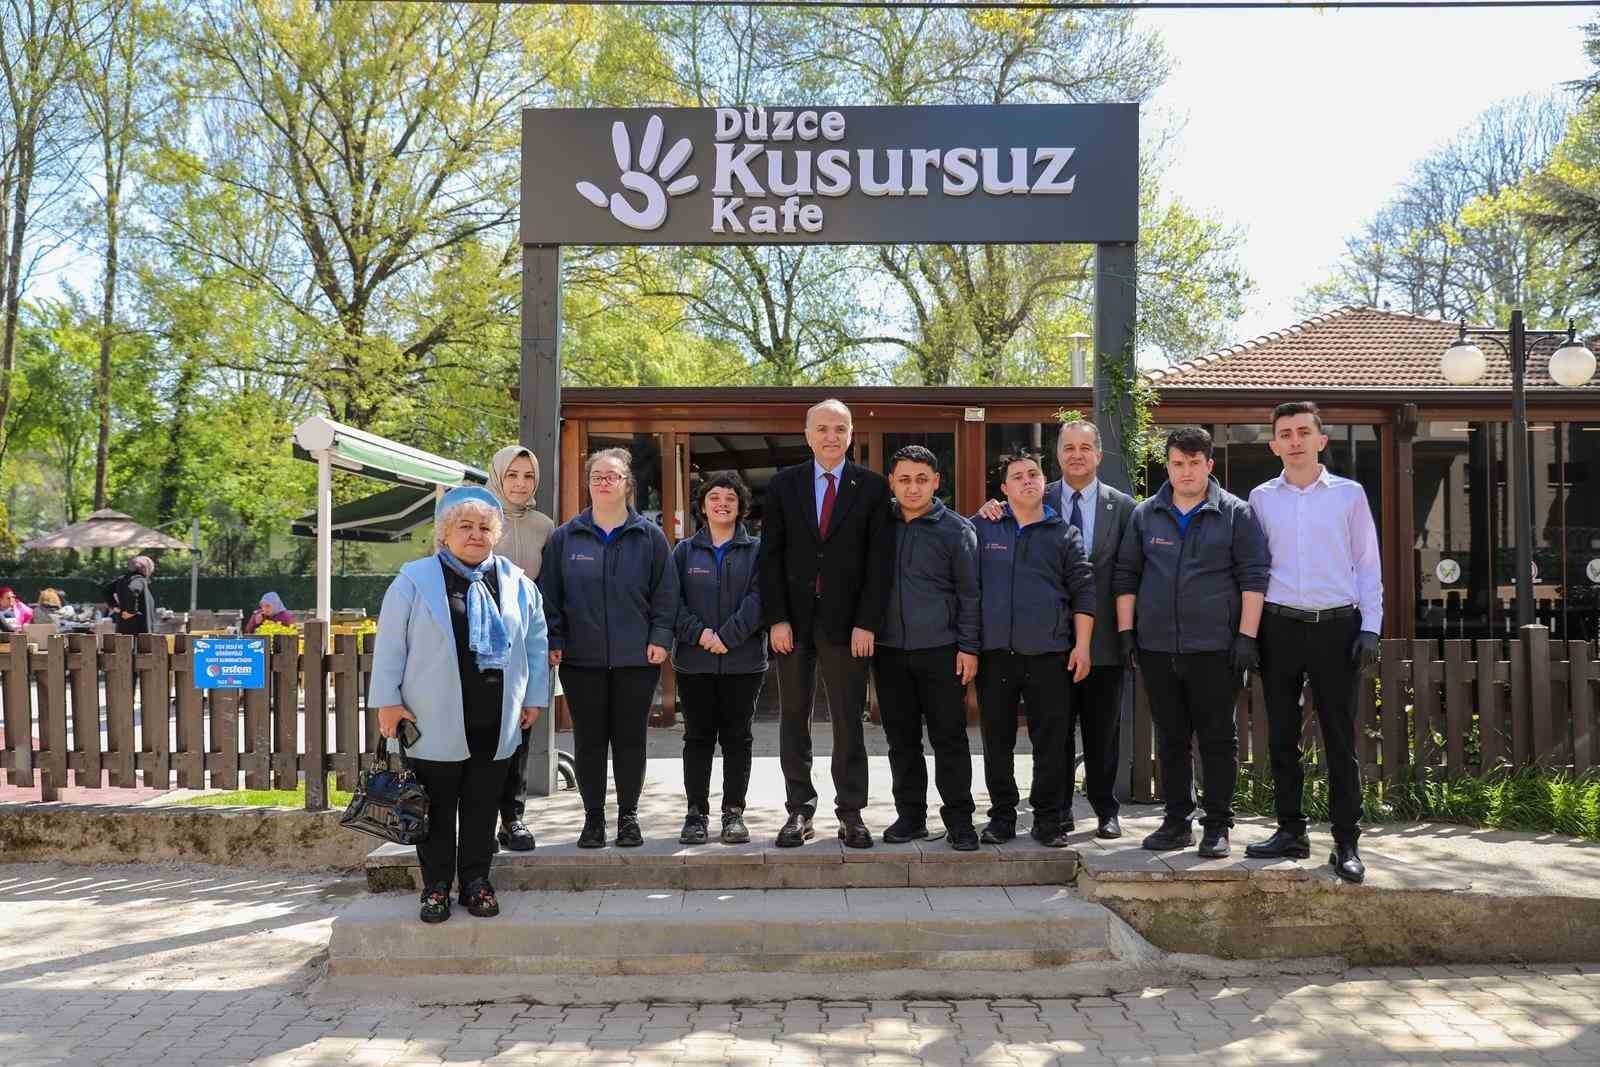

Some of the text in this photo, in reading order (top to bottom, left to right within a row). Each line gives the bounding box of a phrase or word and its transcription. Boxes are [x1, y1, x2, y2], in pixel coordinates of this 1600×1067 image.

[715, 107, 846, 142] Düzce
[712, 142, 1077, 198] Kusursuz
[711, 197, 824, 234] Kafe
